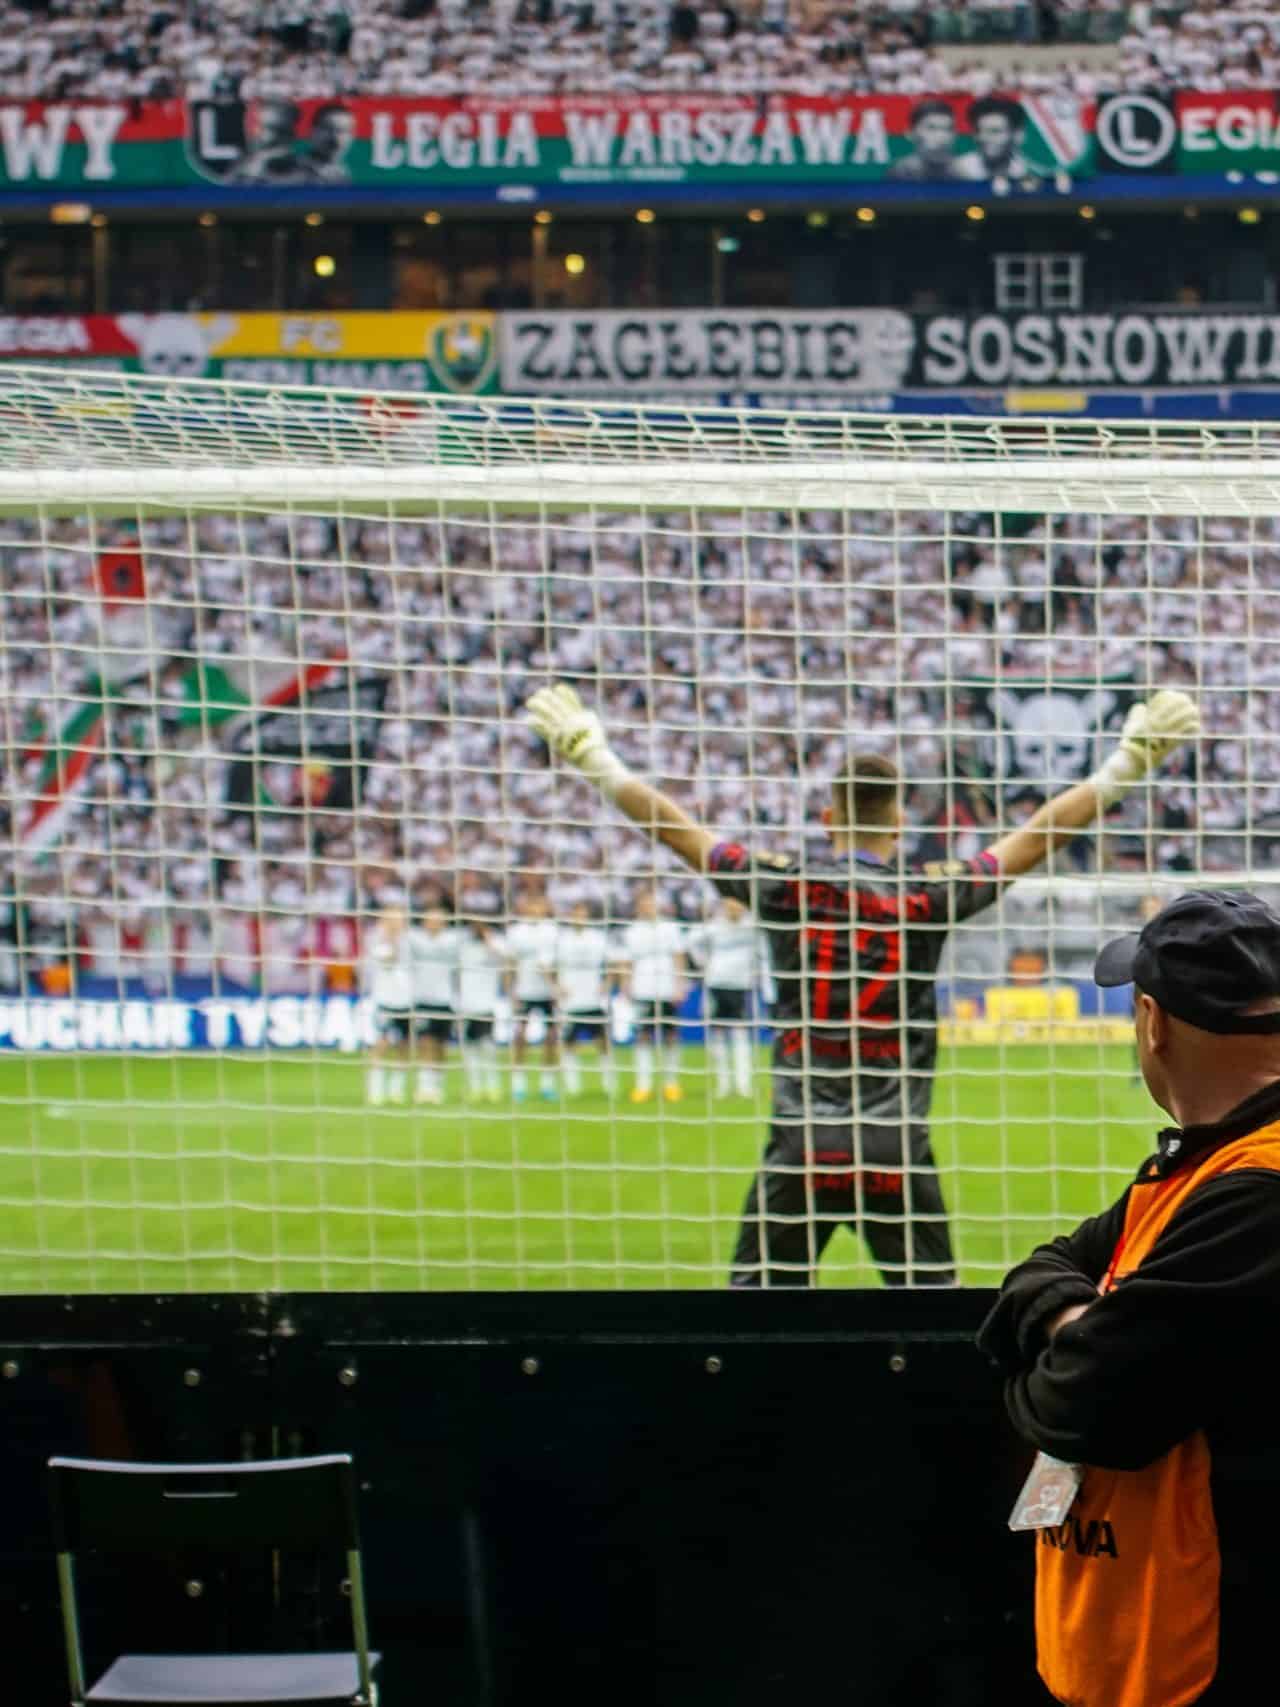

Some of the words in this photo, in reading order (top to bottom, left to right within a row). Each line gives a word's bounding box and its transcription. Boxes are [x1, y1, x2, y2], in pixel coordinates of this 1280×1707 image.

[0, 104, 126, 181] WY
[370, 112, 541, 168] LEGIA
[562, 108, 890, 168] WARSZAWA
[802, 914, 903, 1026] 12
